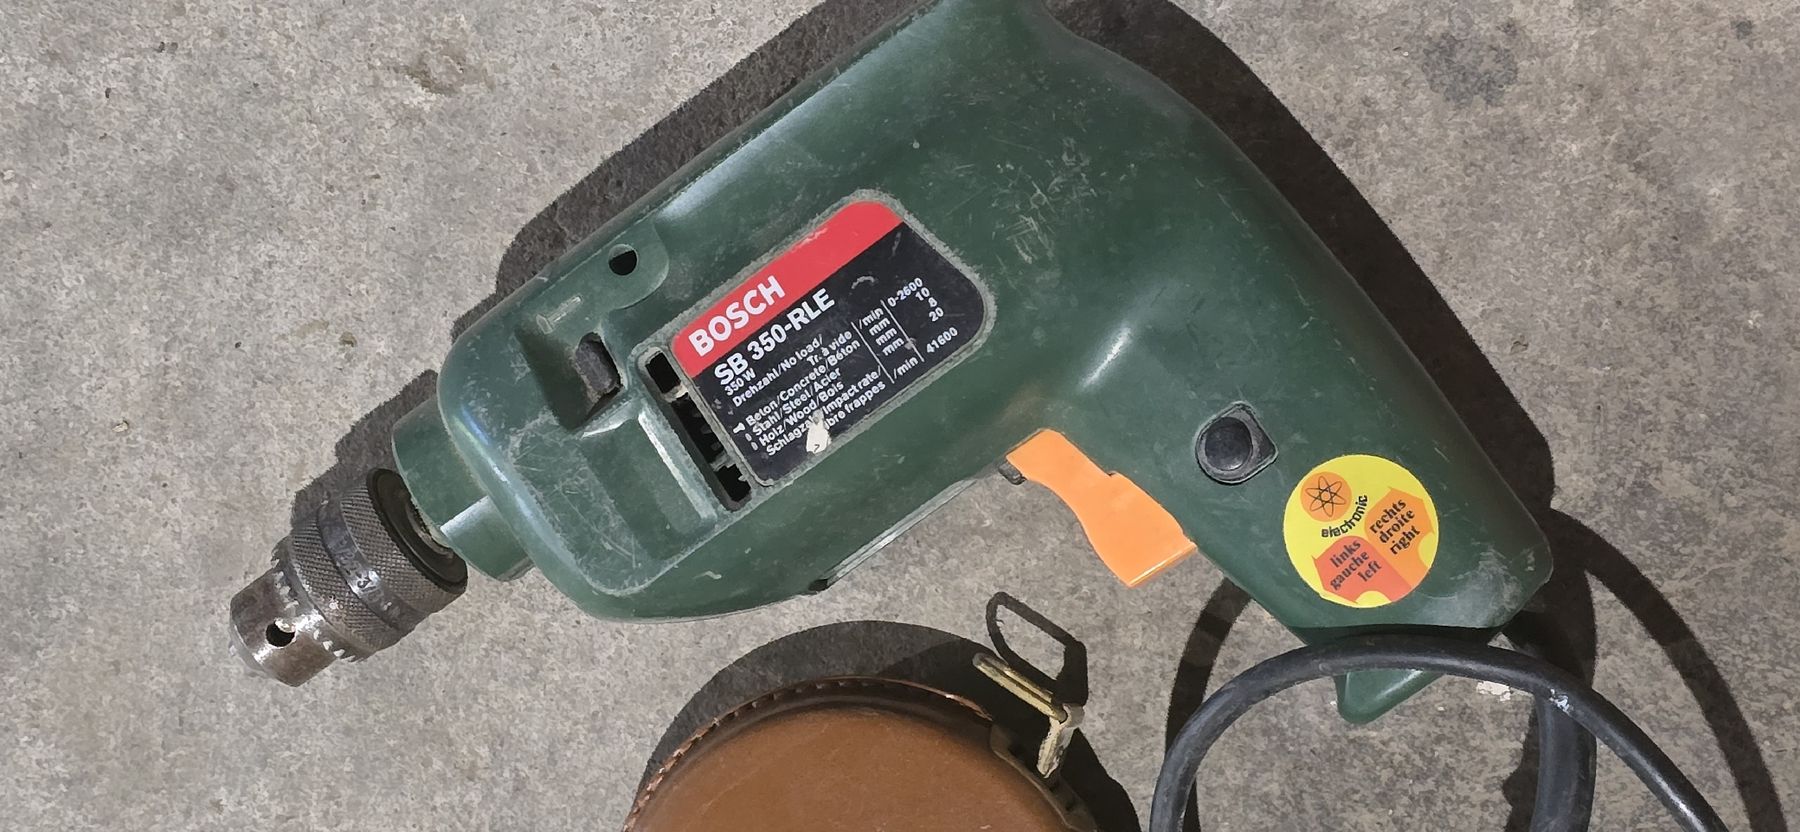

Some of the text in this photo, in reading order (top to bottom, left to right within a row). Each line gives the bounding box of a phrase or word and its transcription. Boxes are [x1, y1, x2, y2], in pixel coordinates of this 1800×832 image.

[688, 275, 786, 357] BOSCH
[828, 331, 852, 351] vide
[859, 307, 884, 329] /min
[887, 277, 923, 307] 0-2600
[869, 317, 891, 336] mm
[915, 287, 930, 301] 10
[714, 287, 835, 385] SB 350-RLE
[724, 367, 757, 396] 350 W
[732, 334, 823, 407] Drehzahl/No load/
[752, 297, 938, 436] Stahl/Steel/Acier mm 8
[758, 307, 944, 447] Holz/Wood/Bois mm 20
[844, 381, 886, 414] frappes
[893, 356, 919, 379] /min
[926, 326, 958, 353] 41600
[858, 365, 881, 389] rate/
[1321, 494, 1368, 537] electronic
[1370, 499, 1406, 534] rechts
[1379, 510, 1415, 543] droite
[1329, 540, 1361, 568] links
[1390, 525, 1420, 555] right
[1330, 551, 1370, 590] gauche
[1357, 560, 1382, 582] left
